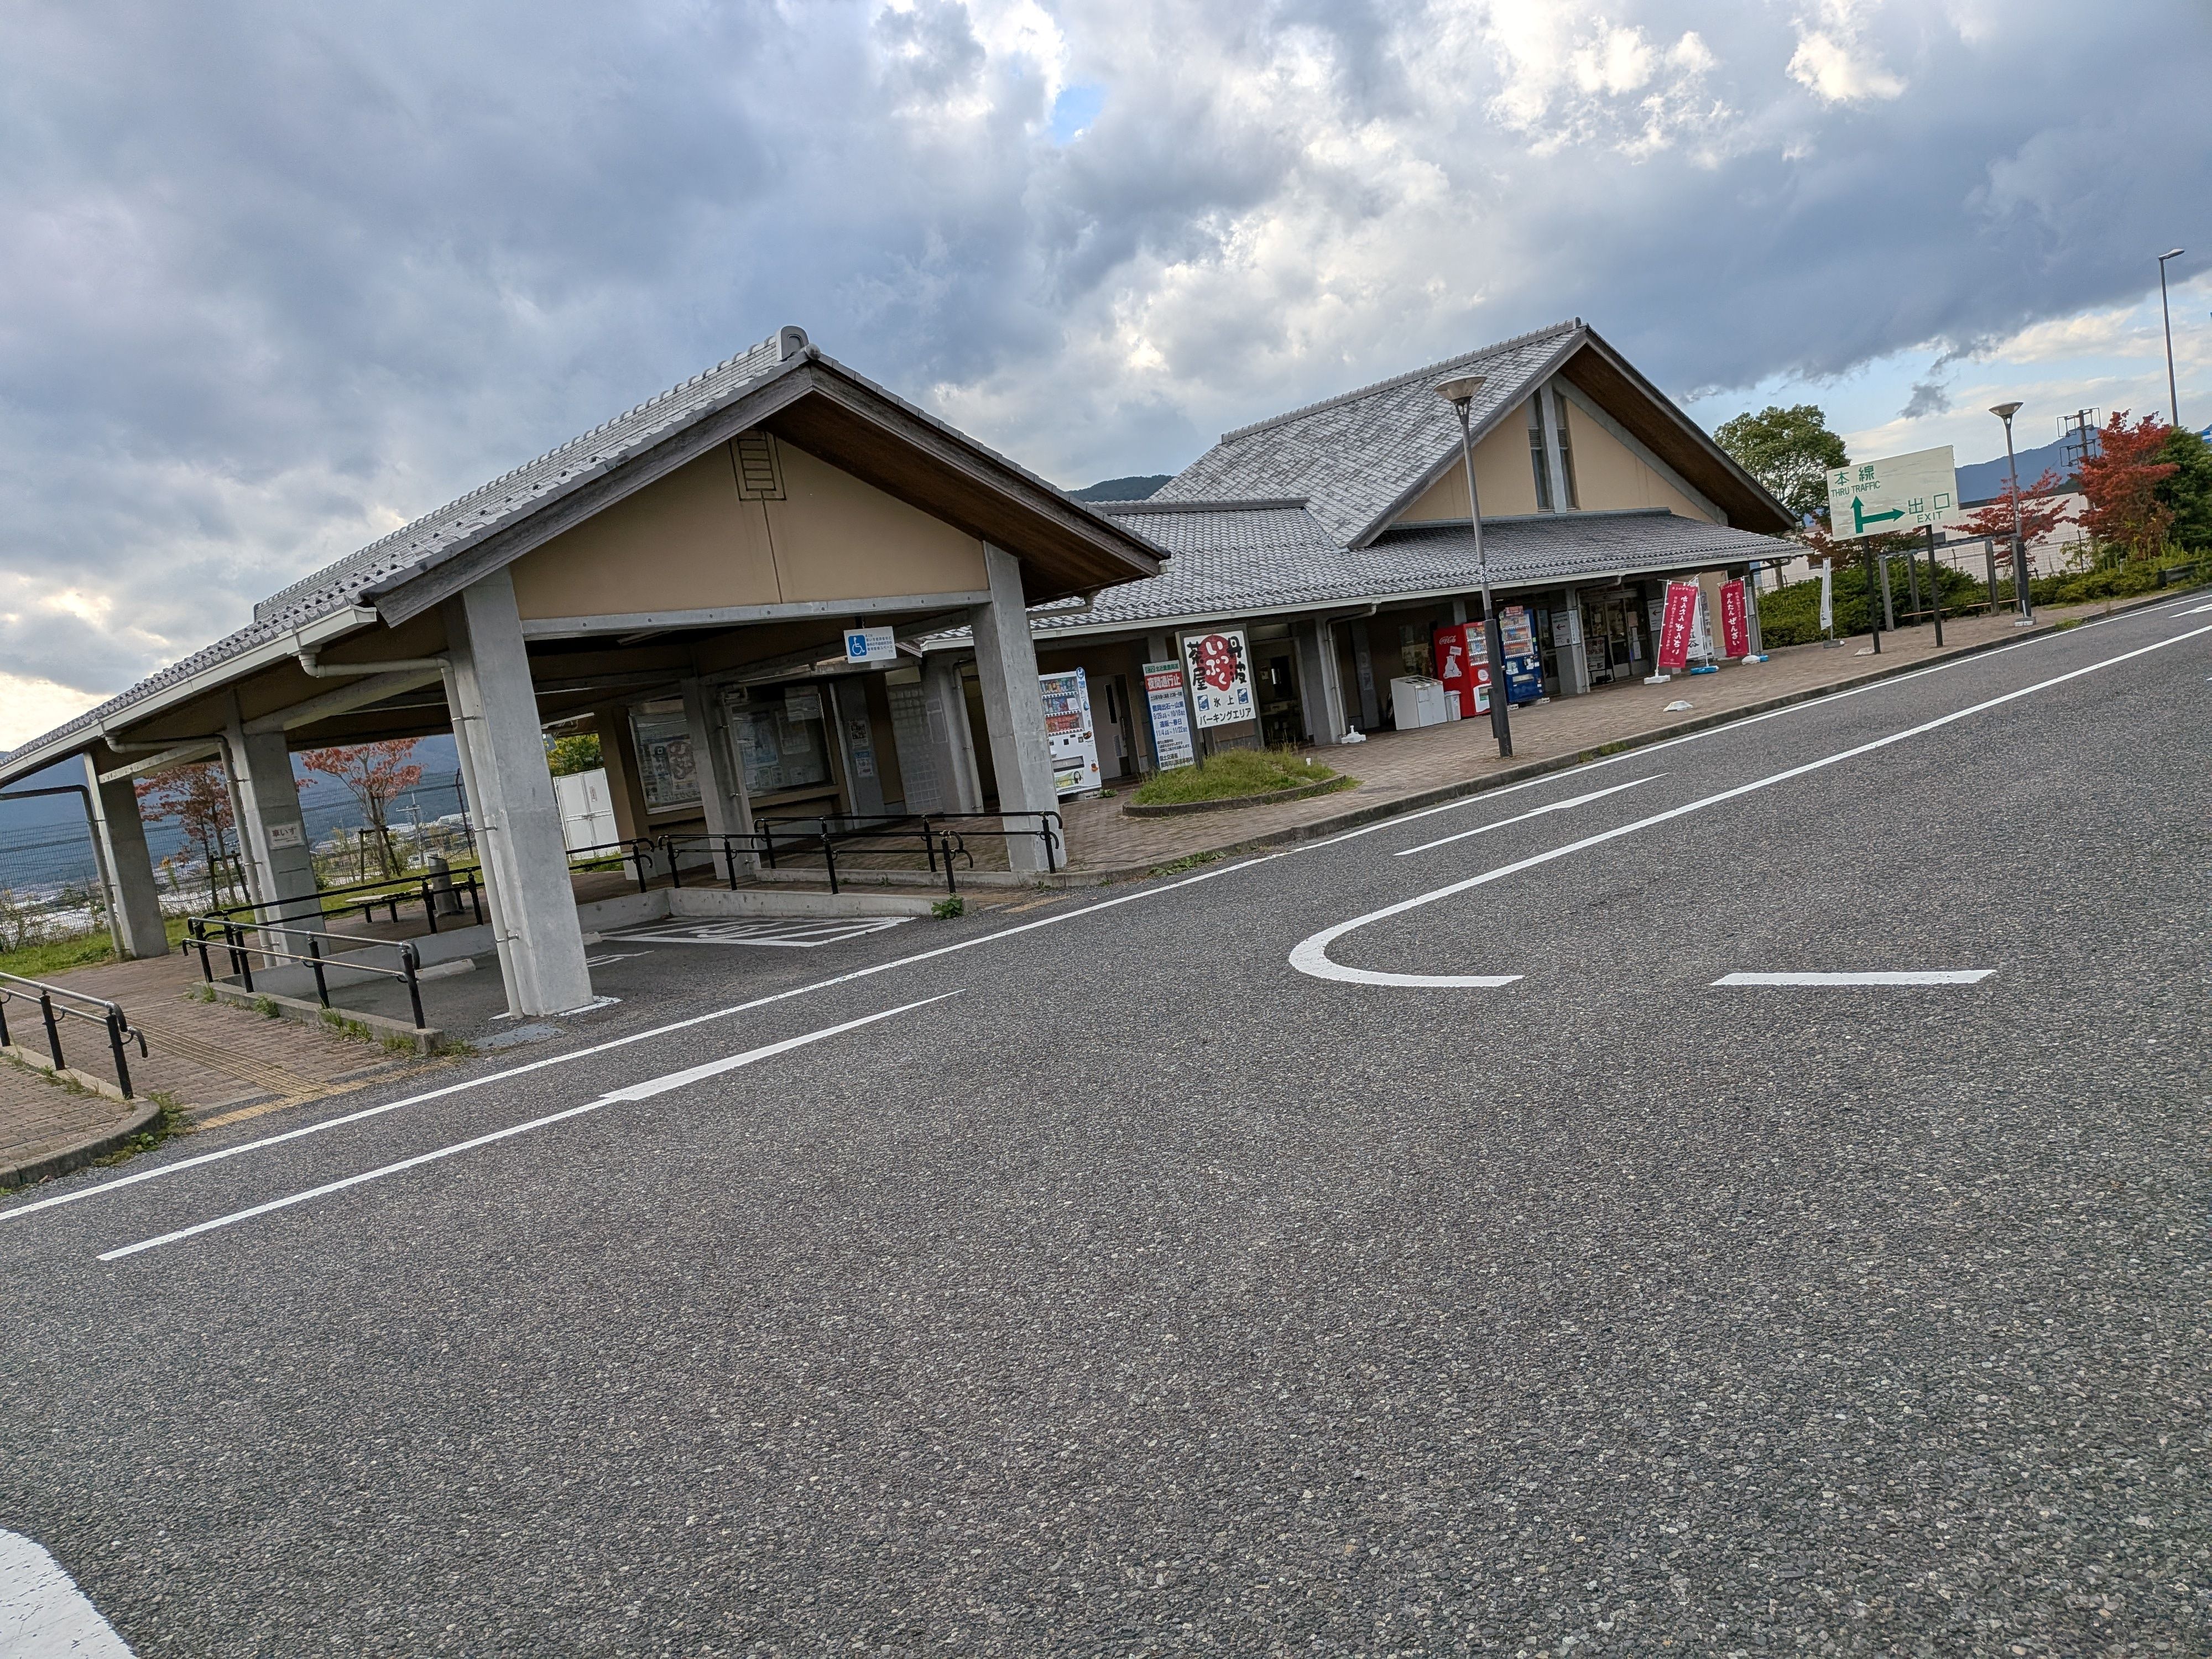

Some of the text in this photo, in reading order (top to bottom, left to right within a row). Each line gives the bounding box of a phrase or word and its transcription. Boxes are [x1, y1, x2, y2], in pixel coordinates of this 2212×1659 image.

[1834, 465, 1875, 486] 本線
[1831, 480, 1881, 497] THRU TRAFFIC
[1908, 493, 1950, 514] 出口
[1917, 510, 1943, 523] EXIT
[1187, 641, 1208, 691] 茶屋
[1206, 641, 1229, 685] いっぷく
[1227, 636, 1247, 684] 丹波
[1147, 674, 1181, 690] 夜間通行止
[1213, 695, 1234, 708] 氷上
[272, 827, 296, 837] 車いす
